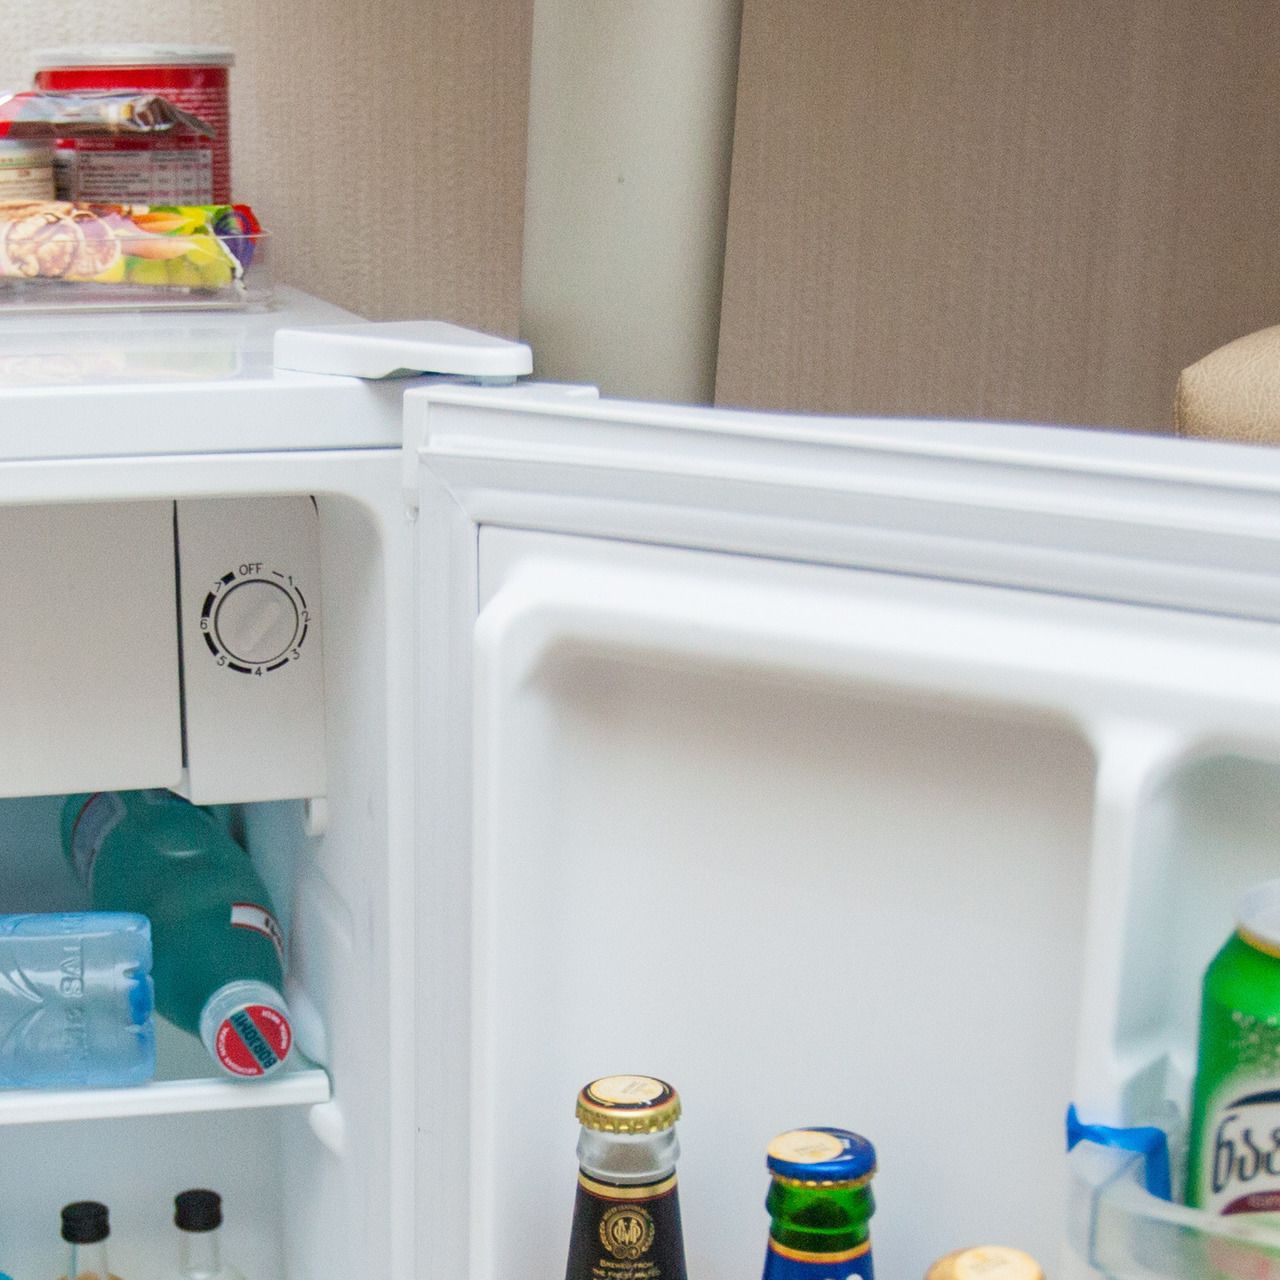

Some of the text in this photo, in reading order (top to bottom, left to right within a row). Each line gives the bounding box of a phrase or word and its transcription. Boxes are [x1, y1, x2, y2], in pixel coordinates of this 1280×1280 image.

[239, 563, 263, 576] OFF
[287, 575, 294, 586] 1
[214, 581, 222, 592] 7
[301, 610, 311, 623] 2
[200, 619, 208, 630] 6
[291, 648, 300, 660] 3
[217, 656, 227, 666] 5
[254, 666, 262, 677] 4
